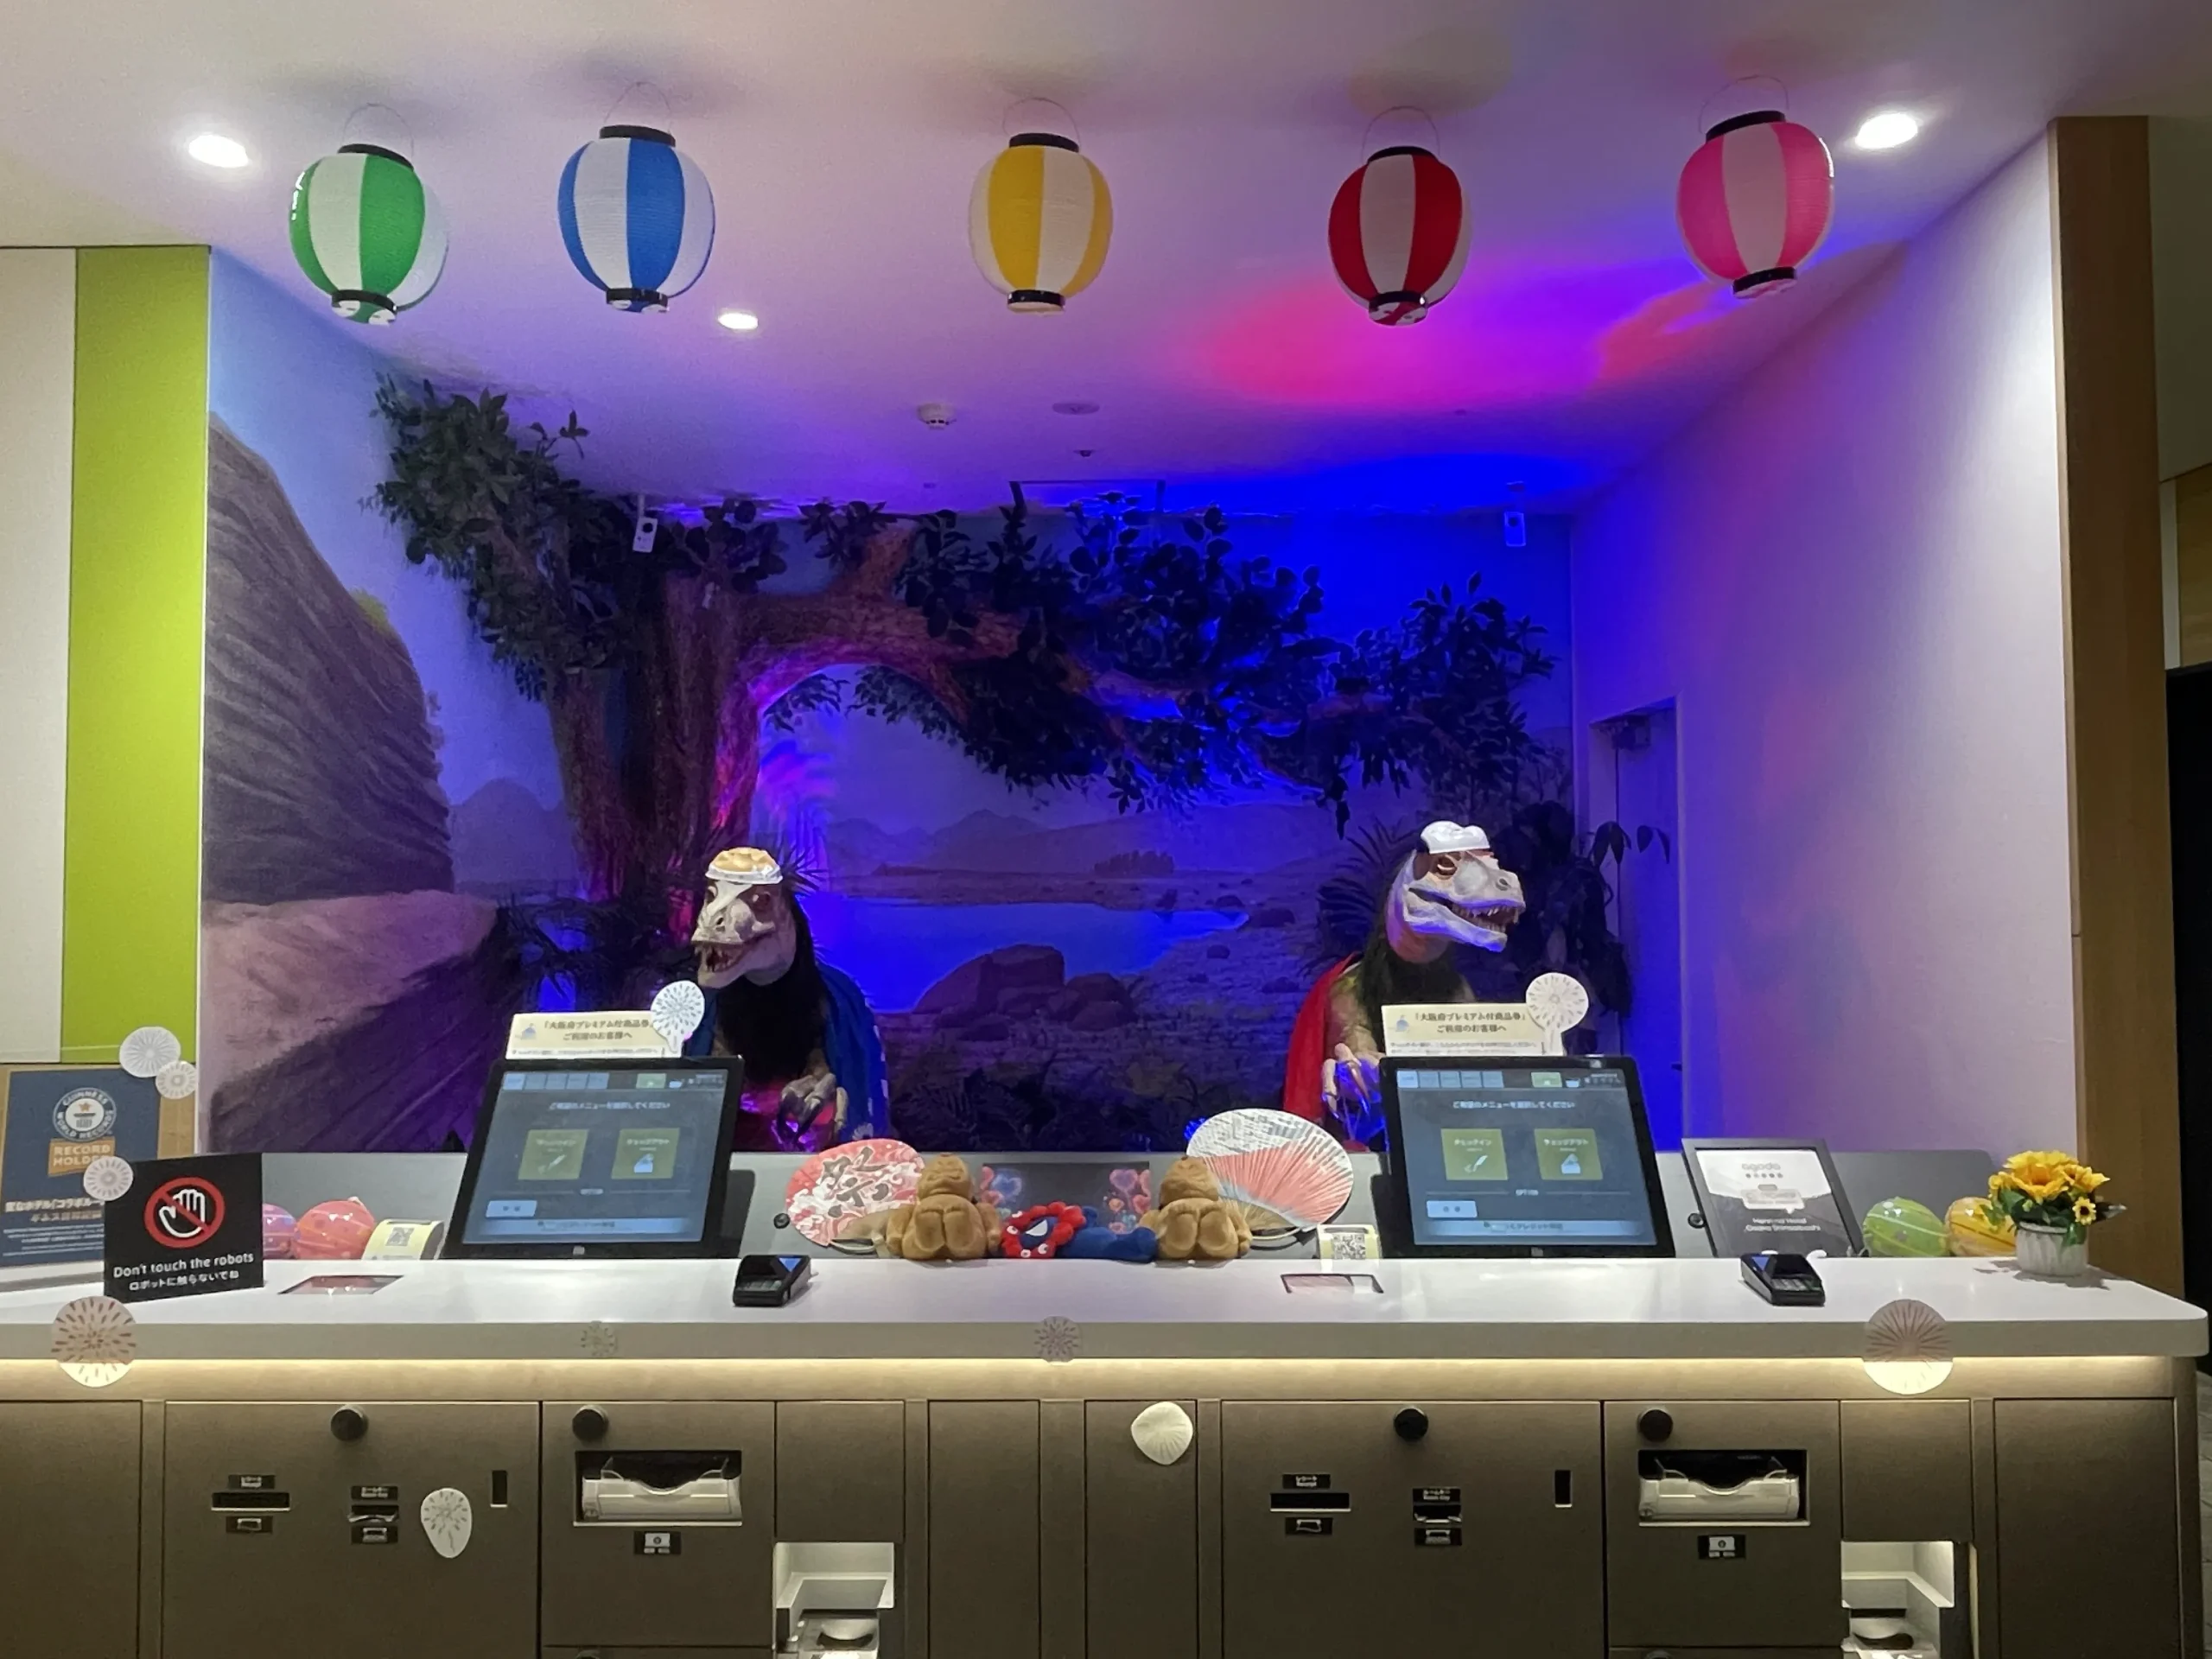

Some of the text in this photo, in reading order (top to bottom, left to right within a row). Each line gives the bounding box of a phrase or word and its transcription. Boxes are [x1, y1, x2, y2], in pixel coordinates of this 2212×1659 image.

[54, 1144, 111, 1156] RECORD
[113, 1253, 254, 1278] Don't touch the robots
